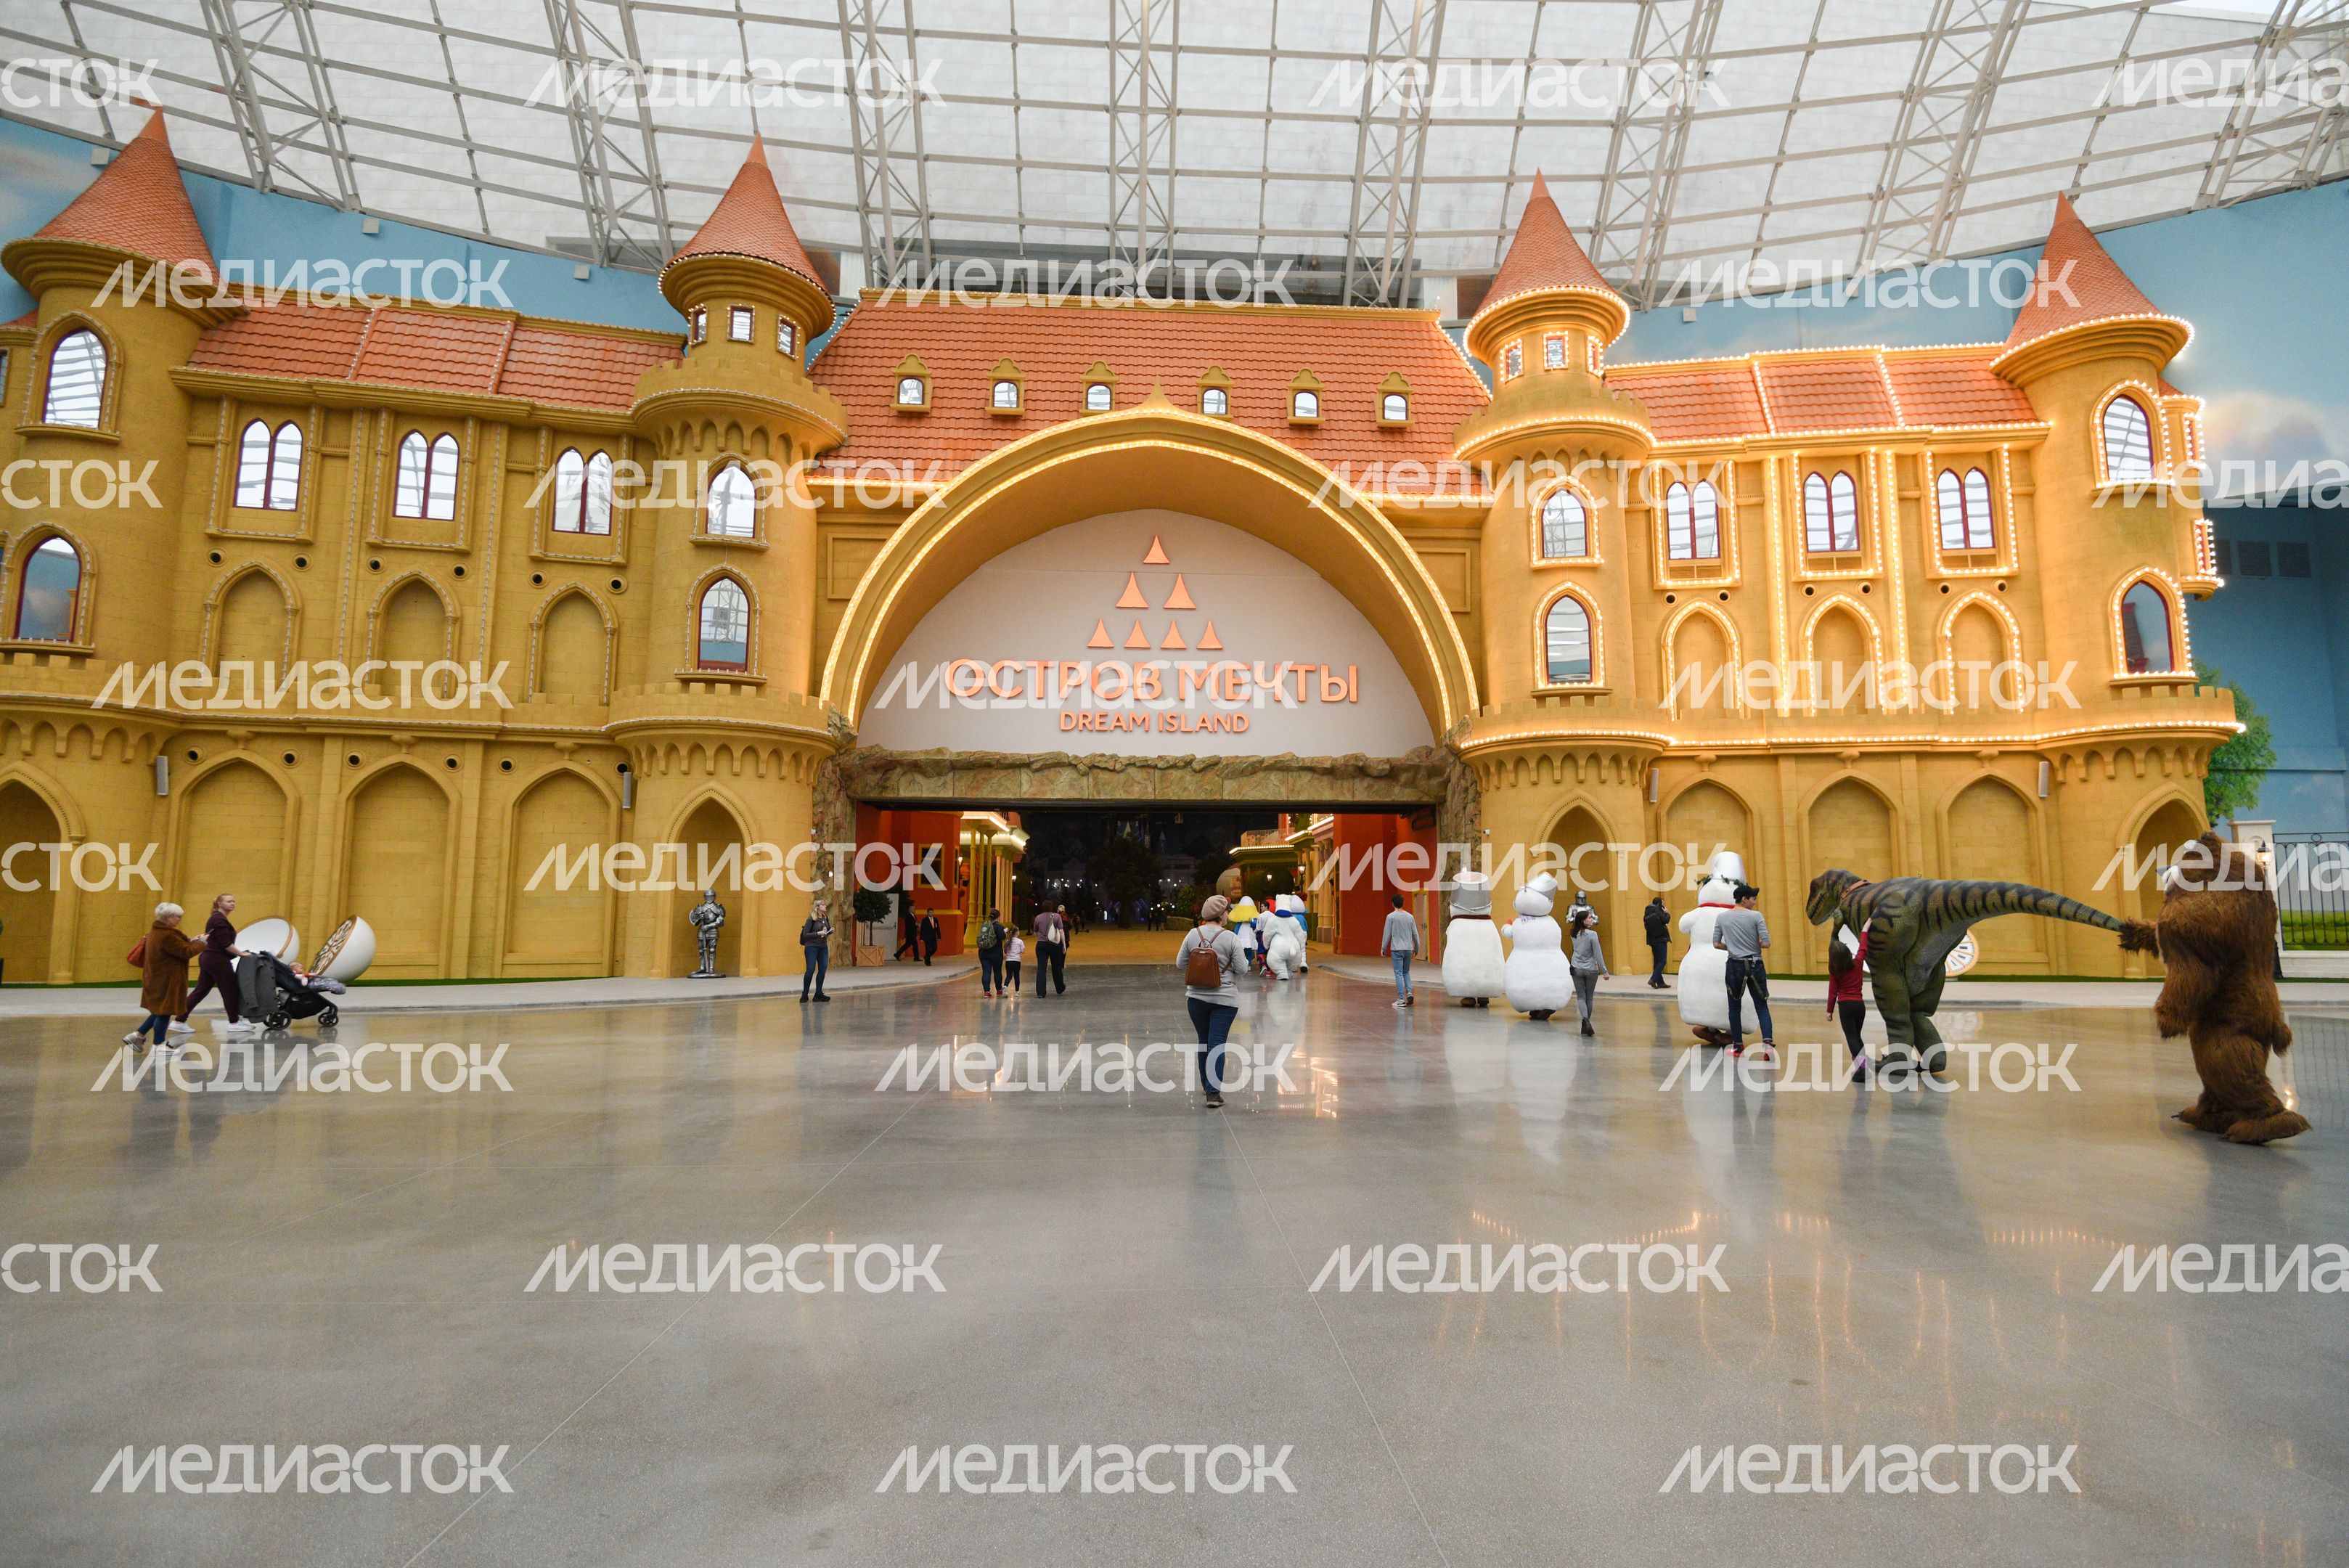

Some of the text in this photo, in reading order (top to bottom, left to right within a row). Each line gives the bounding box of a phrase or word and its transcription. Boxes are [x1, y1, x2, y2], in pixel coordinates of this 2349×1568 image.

[944, 658, 1358, 703] ОСТРОВ МЕЧТЫ
[1059, 711, 1250, 733] DREAM ISLAND
